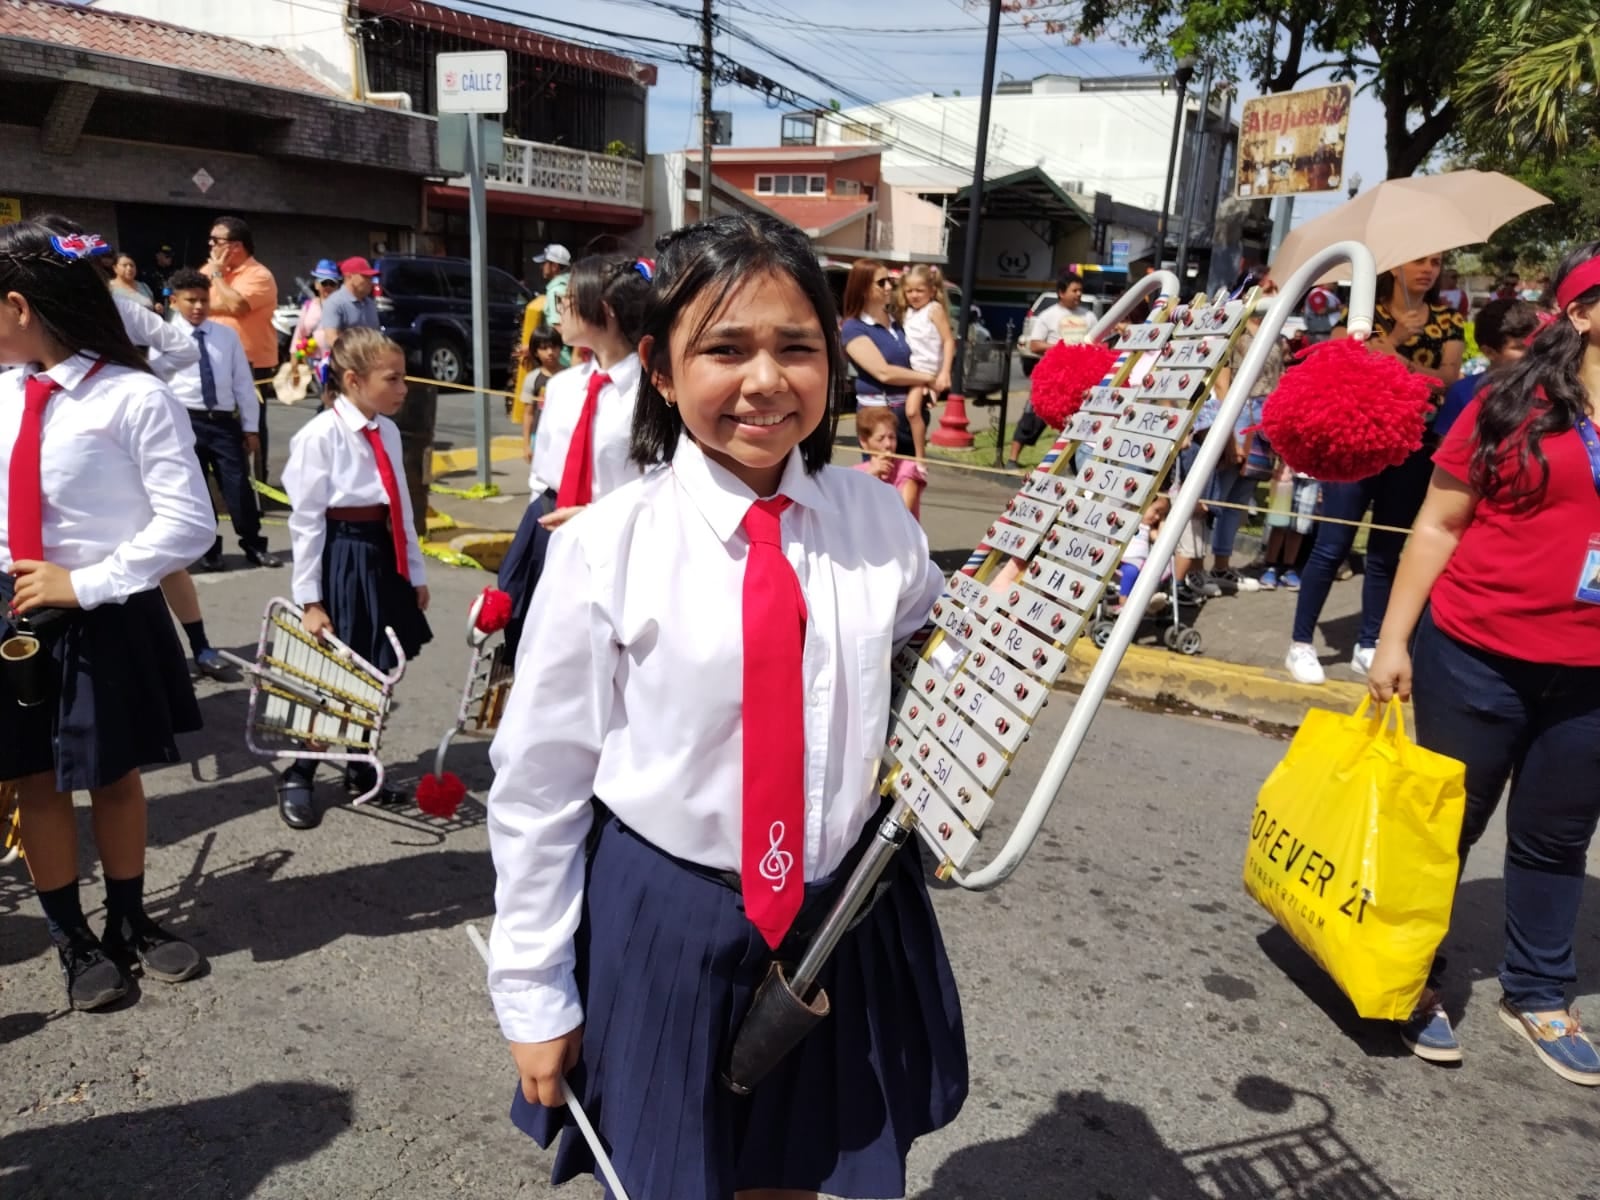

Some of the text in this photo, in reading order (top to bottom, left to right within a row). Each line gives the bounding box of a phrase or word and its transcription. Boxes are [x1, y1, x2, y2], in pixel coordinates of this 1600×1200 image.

[495, 72, 502, 90] 2
[1175, 346, 1194, 362] FA
[1138, 411, 1161, 431] RE
[1047, 569, 1066, 591] FA
[948, 722, 964, 748] LA
[913, 787, 931, 813] FA
